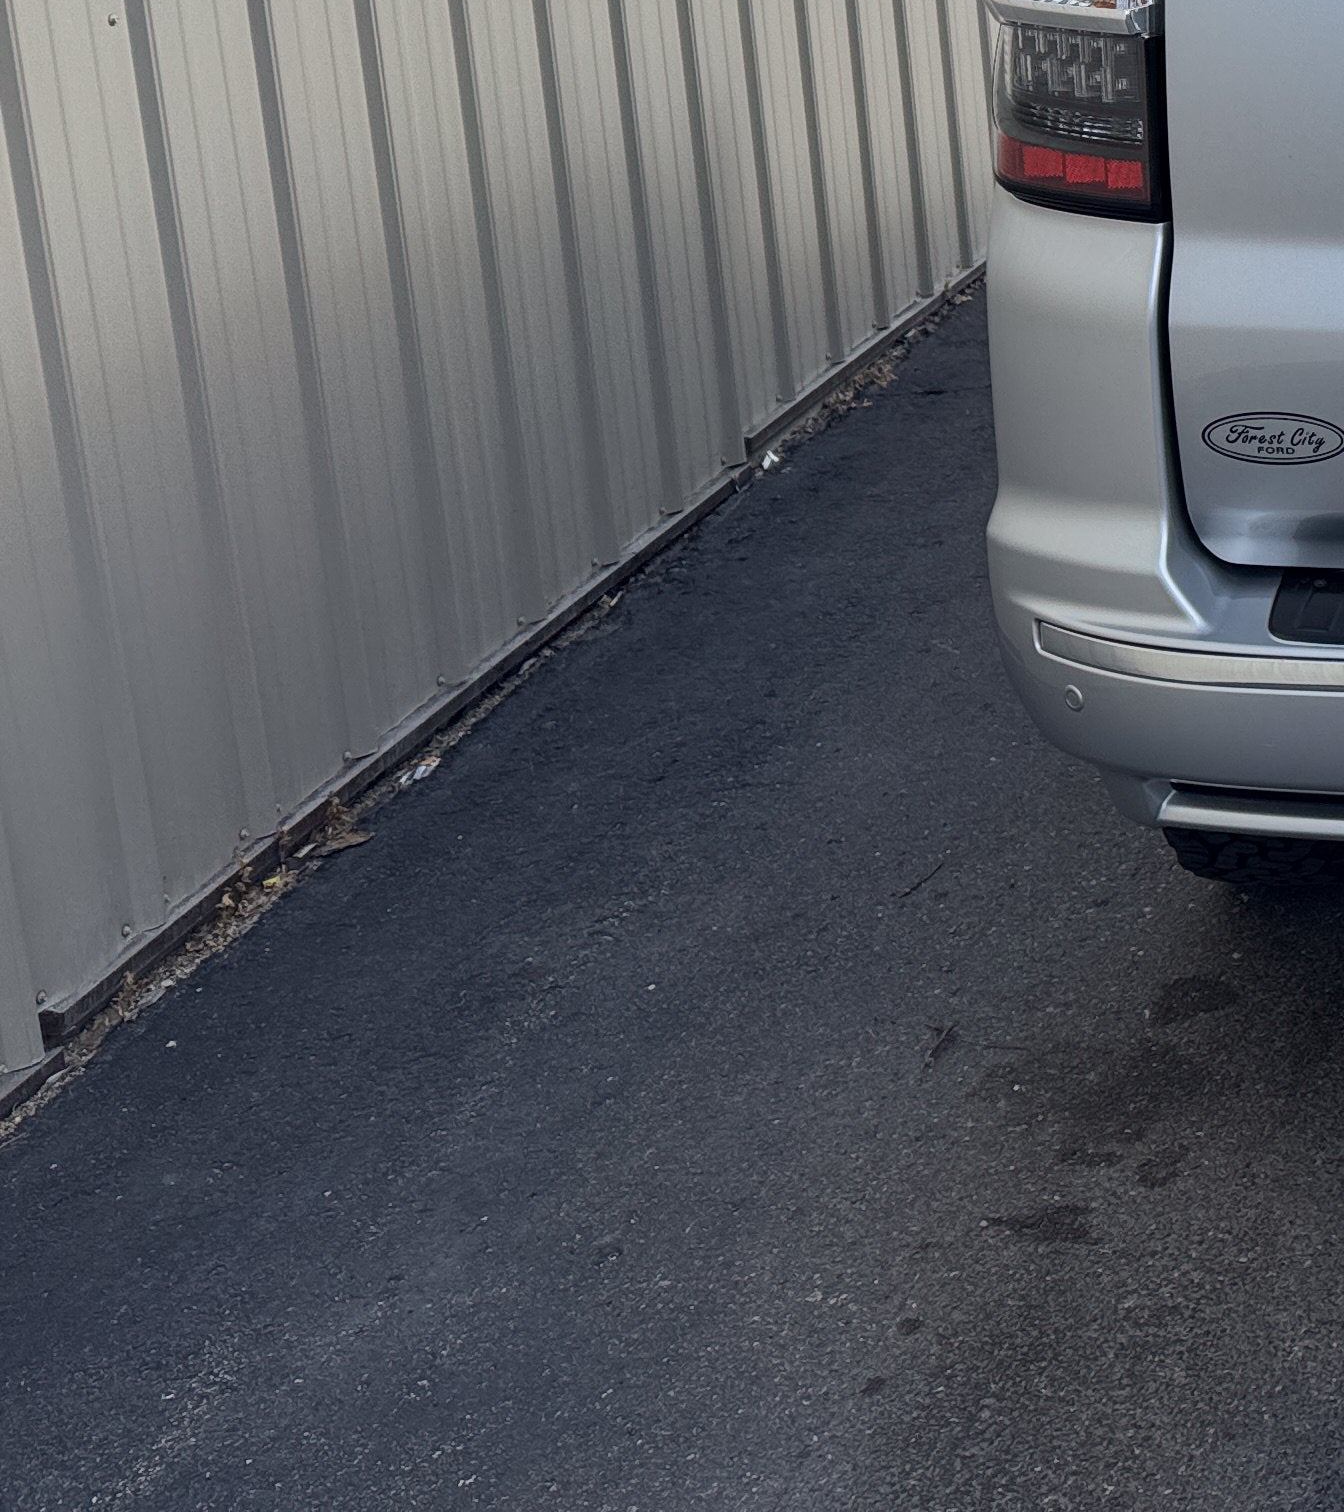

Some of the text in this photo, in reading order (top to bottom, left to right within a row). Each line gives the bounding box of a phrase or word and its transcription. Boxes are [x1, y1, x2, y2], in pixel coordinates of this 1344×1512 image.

[1225, 424, 1326, 454] Forest City
[1257, 446, 1296, 455] FORD
